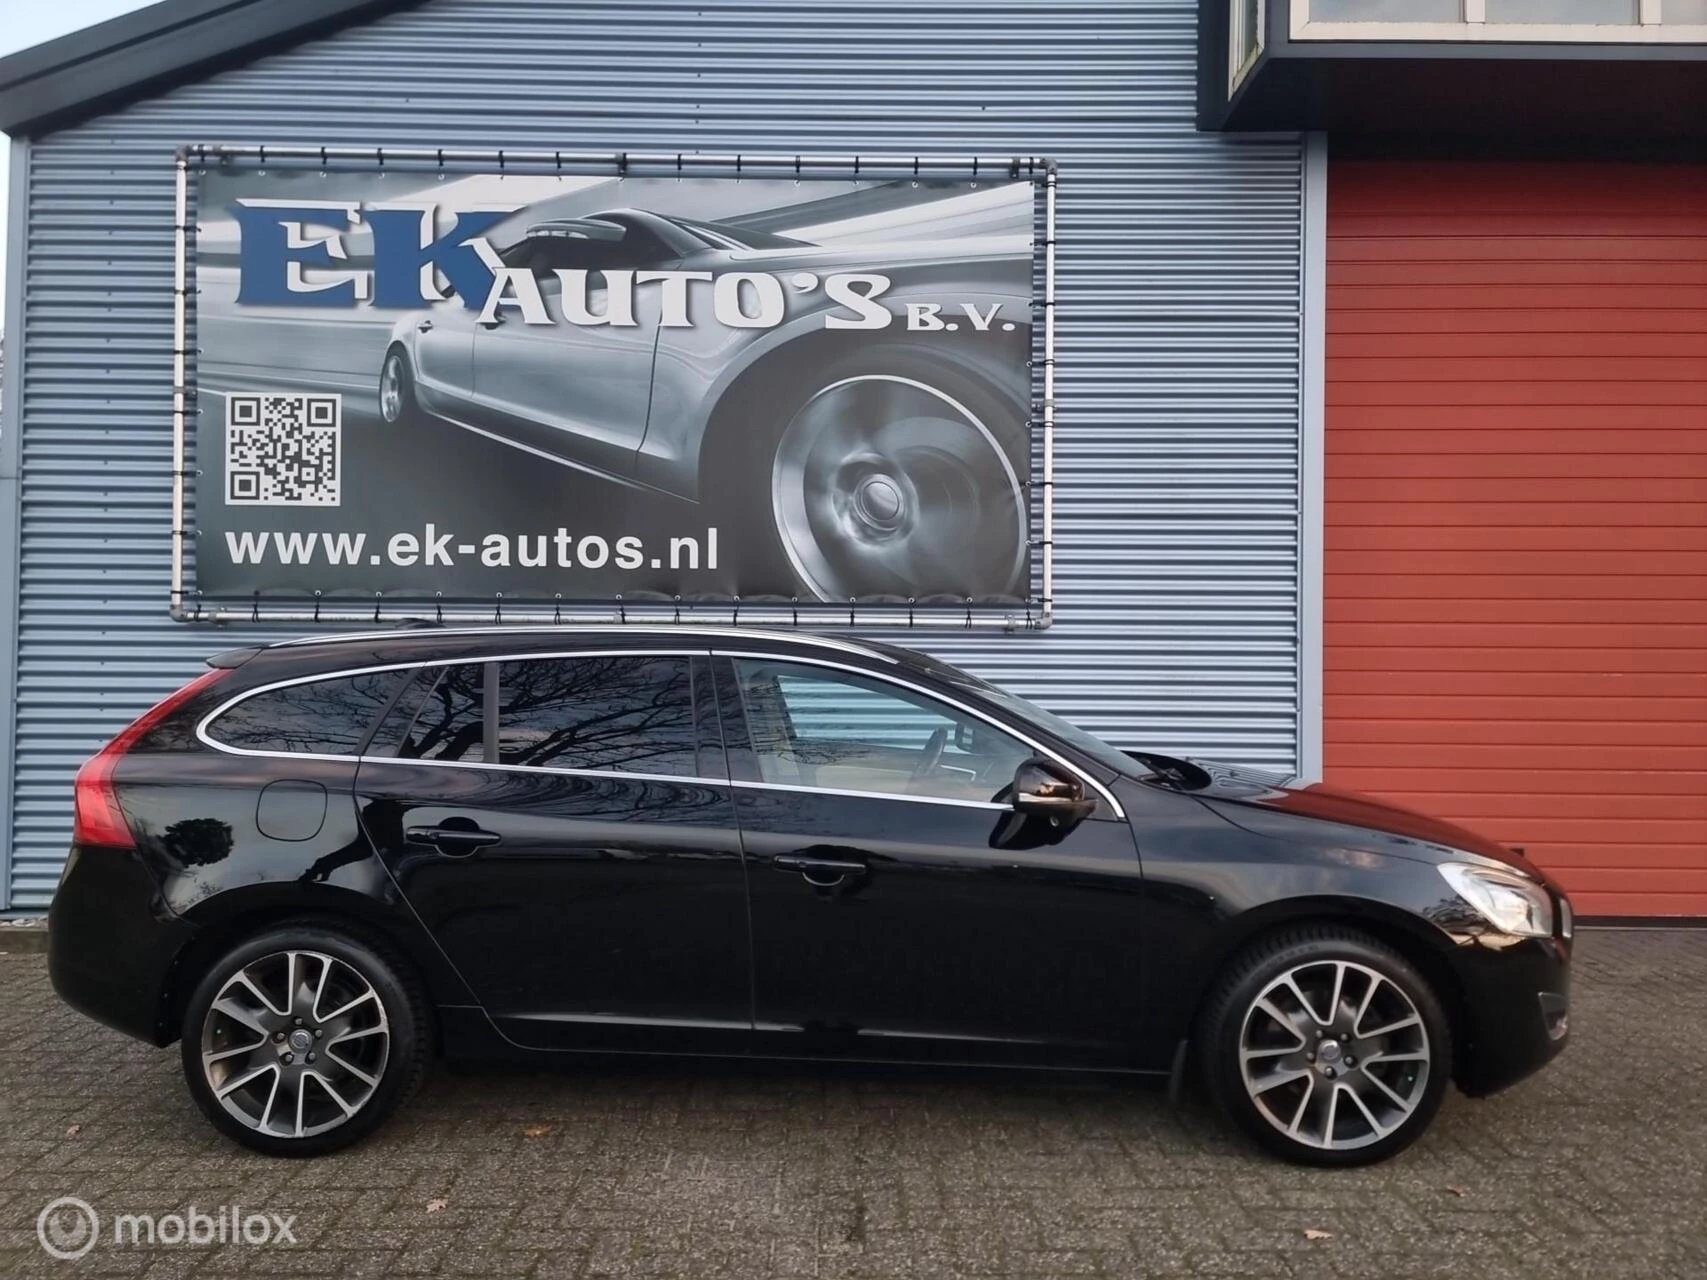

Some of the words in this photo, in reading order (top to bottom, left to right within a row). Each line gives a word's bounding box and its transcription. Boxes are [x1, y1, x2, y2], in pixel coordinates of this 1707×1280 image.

[235, 198, 522, 309] EK
[906, 302, 1016, 332] B.V.
[225, 523, 719, 569] www.ek-autos.nl
